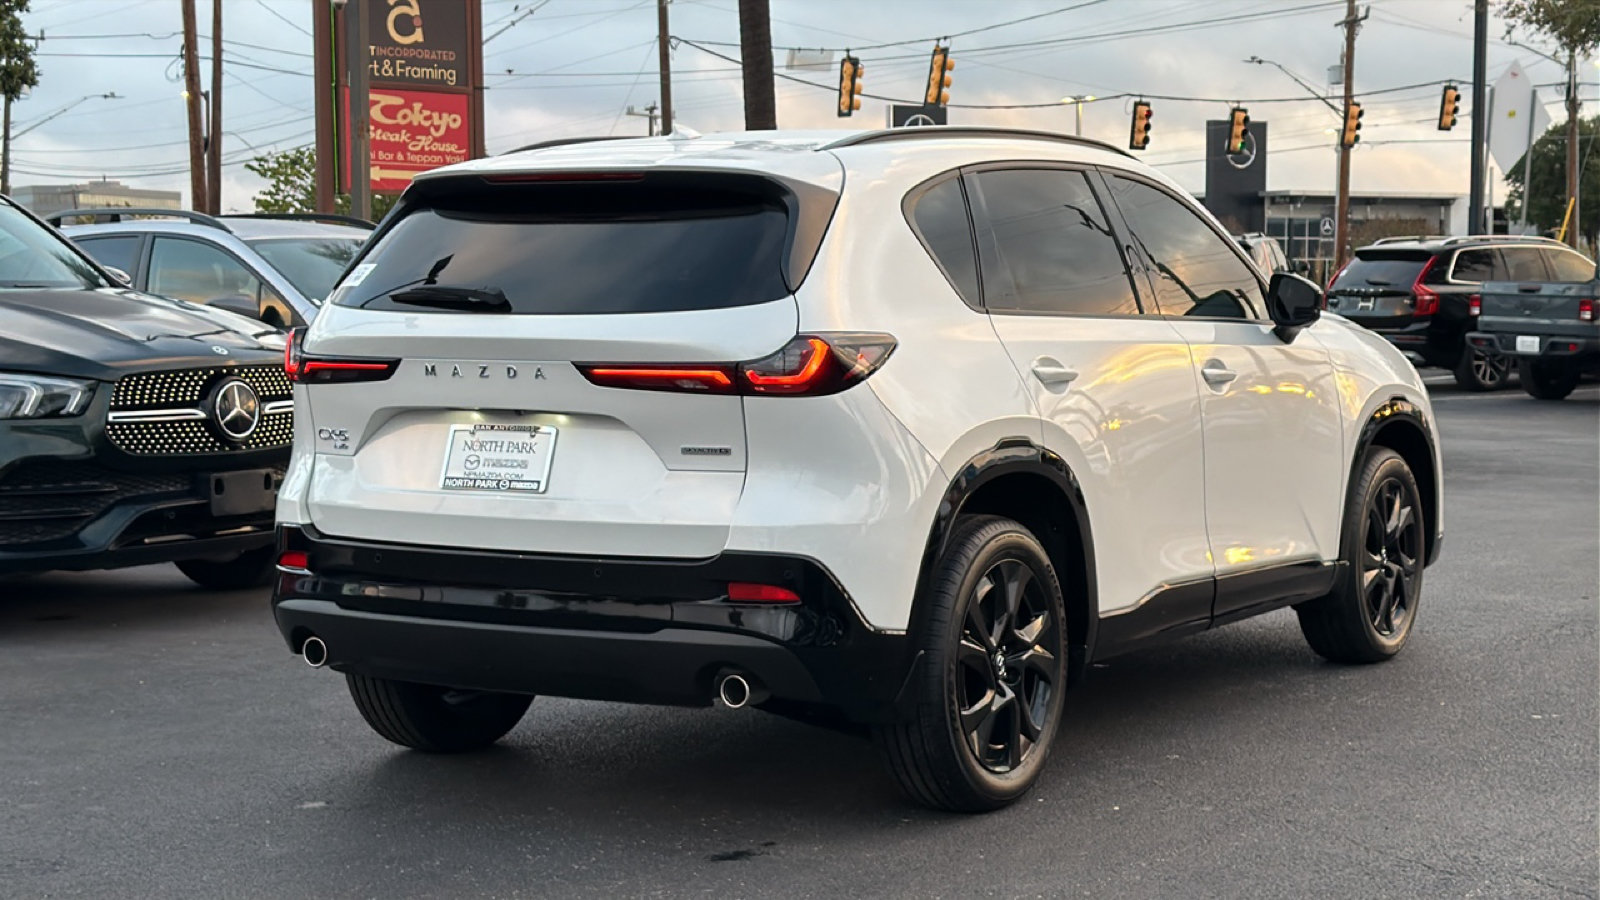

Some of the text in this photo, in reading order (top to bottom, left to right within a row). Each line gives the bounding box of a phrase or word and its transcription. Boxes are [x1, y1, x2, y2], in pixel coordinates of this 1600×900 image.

[381, 60, 396, 77] &
[396, 60, 456, 86] Framing
[369, 93, 462, 137] Tokyo
[369, 125, 466, 153] Steak House
[378, 151, 394, 160] Bar
[397, 152, 404, 160] &
[407, 152, 443, 164] Teppan
[425, 363, 547, 380] MAZDA
[463, 440, 537, 454] NORTH PARK
[445, 478, 475, 488] NORTH
[475, 479, 498, 489] PARK
